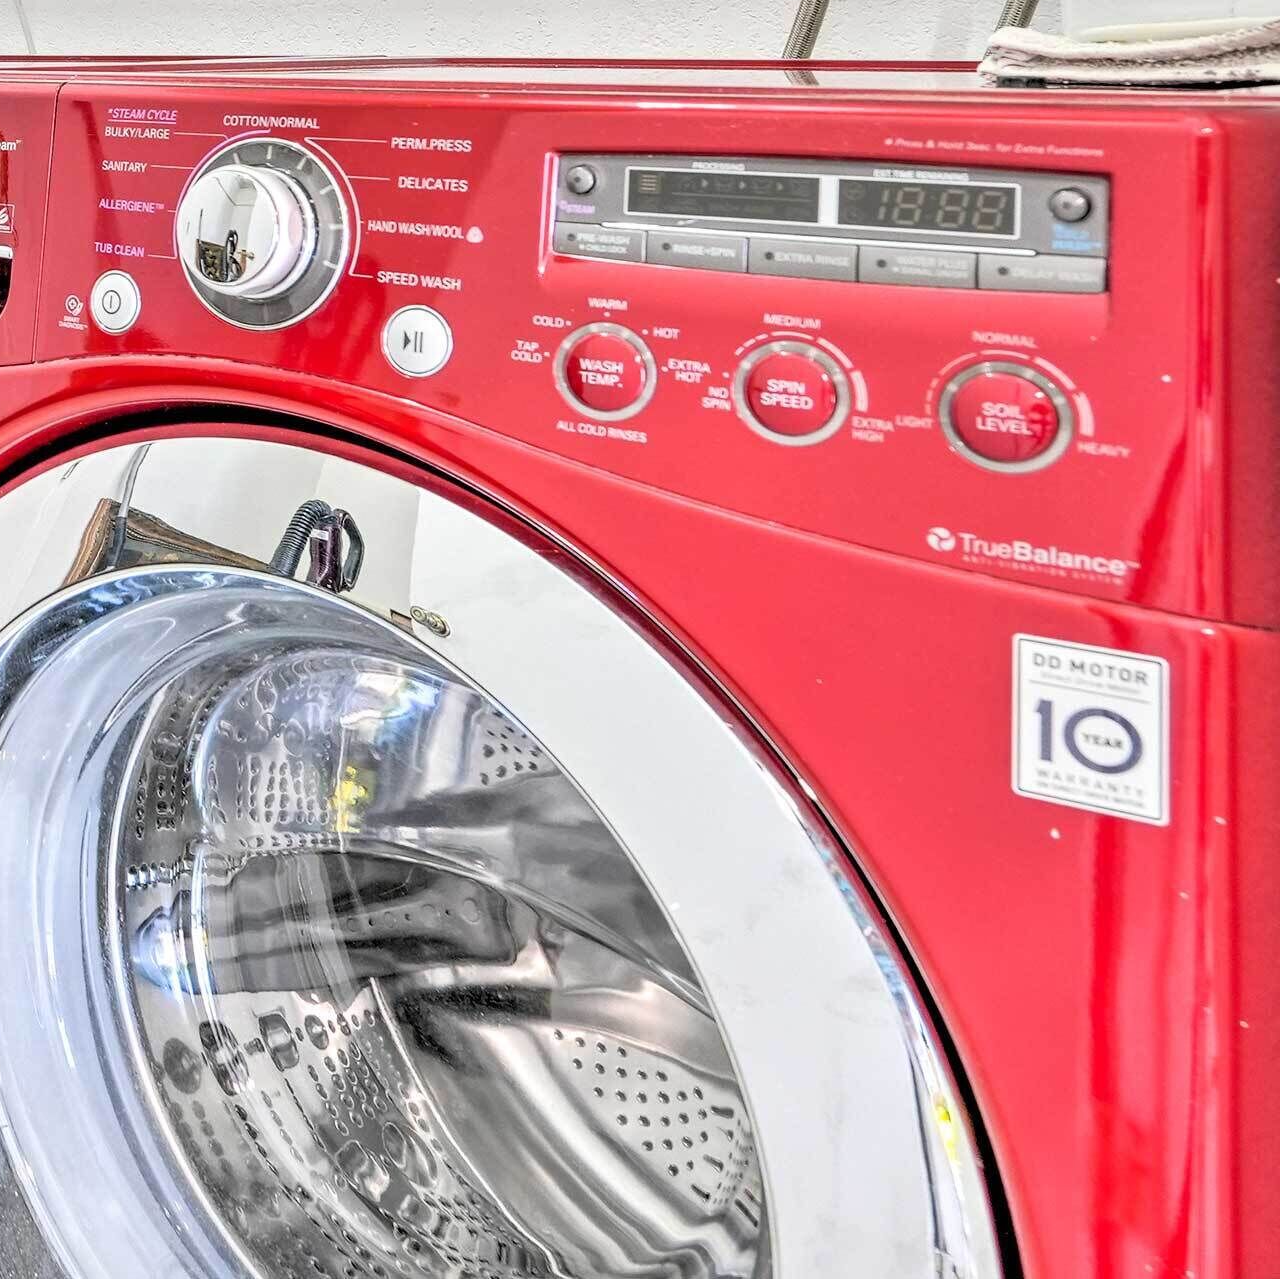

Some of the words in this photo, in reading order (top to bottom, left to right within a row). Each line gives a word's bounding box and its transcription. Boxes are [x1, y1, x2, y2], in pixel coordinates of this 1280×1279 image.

[147, 110, 178, 121] CYCLE
[223, 115, 320, 129] COTTON/NORMAL
[105, 127, 170, 140] BULKY/LARGE
[996, 144, 1013, 154] for
[1014, 144, 1045, 154] Extra
[1046, 145, 1104, 157] Functions
[102, 160, 147, 173] SANITARY
[398, 176, 468, 192] DELICATES
[368, 220, 397, 233] HAND
[398, 222, 464, 239] WASH/WOOL
[95, 242, 113, 255] TUB
[114, 243, 145, 257] CLEAN
[775, 251, 813, 265] EXTRA
[377, 271, 419, 287] SPEED
[420, 276, 461, 292] WASH
[588, 298, 628, 311] WARM
[533, 315, 564, 328] COLD
[764, 313, 821, 329] MEDIUM
[653, 327, 680, 339] HOT
[972, 331, 1038, 348] NORMAL
[516, 340, 539, 351] TAP
[511, 350, 542, 363] COLD
[580, 359, 623, 374] WASH
[668, 359, 711, 373] EXTRA
[580, 371, 623, 388] TEMP.
[676, 371, 703, 383] HOT
[708, 387, 729, 399] NO
[767, 379, 805, 395] SPIN
[702, 398, 731, 410] SPIN
[761, 393, 813, 410] SPEED
[982, 402, 1025, 420] SOIL
[852, 416, 895, 432] EXTRA
[896, 416, 933, 428] LIGHT
[976, 417, 1032, 435] LEVEL
[557, 421, 576, 432] ALL
[578, 424, 606, 438] COLD
[608, 428, 647, 443] RINSES
[852, 429, 884, 442] HIGH
[1078, 442, 1130, 457] HEAVY
[1032, 652, 1061, 669] DD
[1070, 659, 1149, 686] MOTOR
[1035, 699, 1143, 775] 10
[1082, 732, 1124, 750] YEAR
[1036, 769, 1145, 798] WARRANTY
